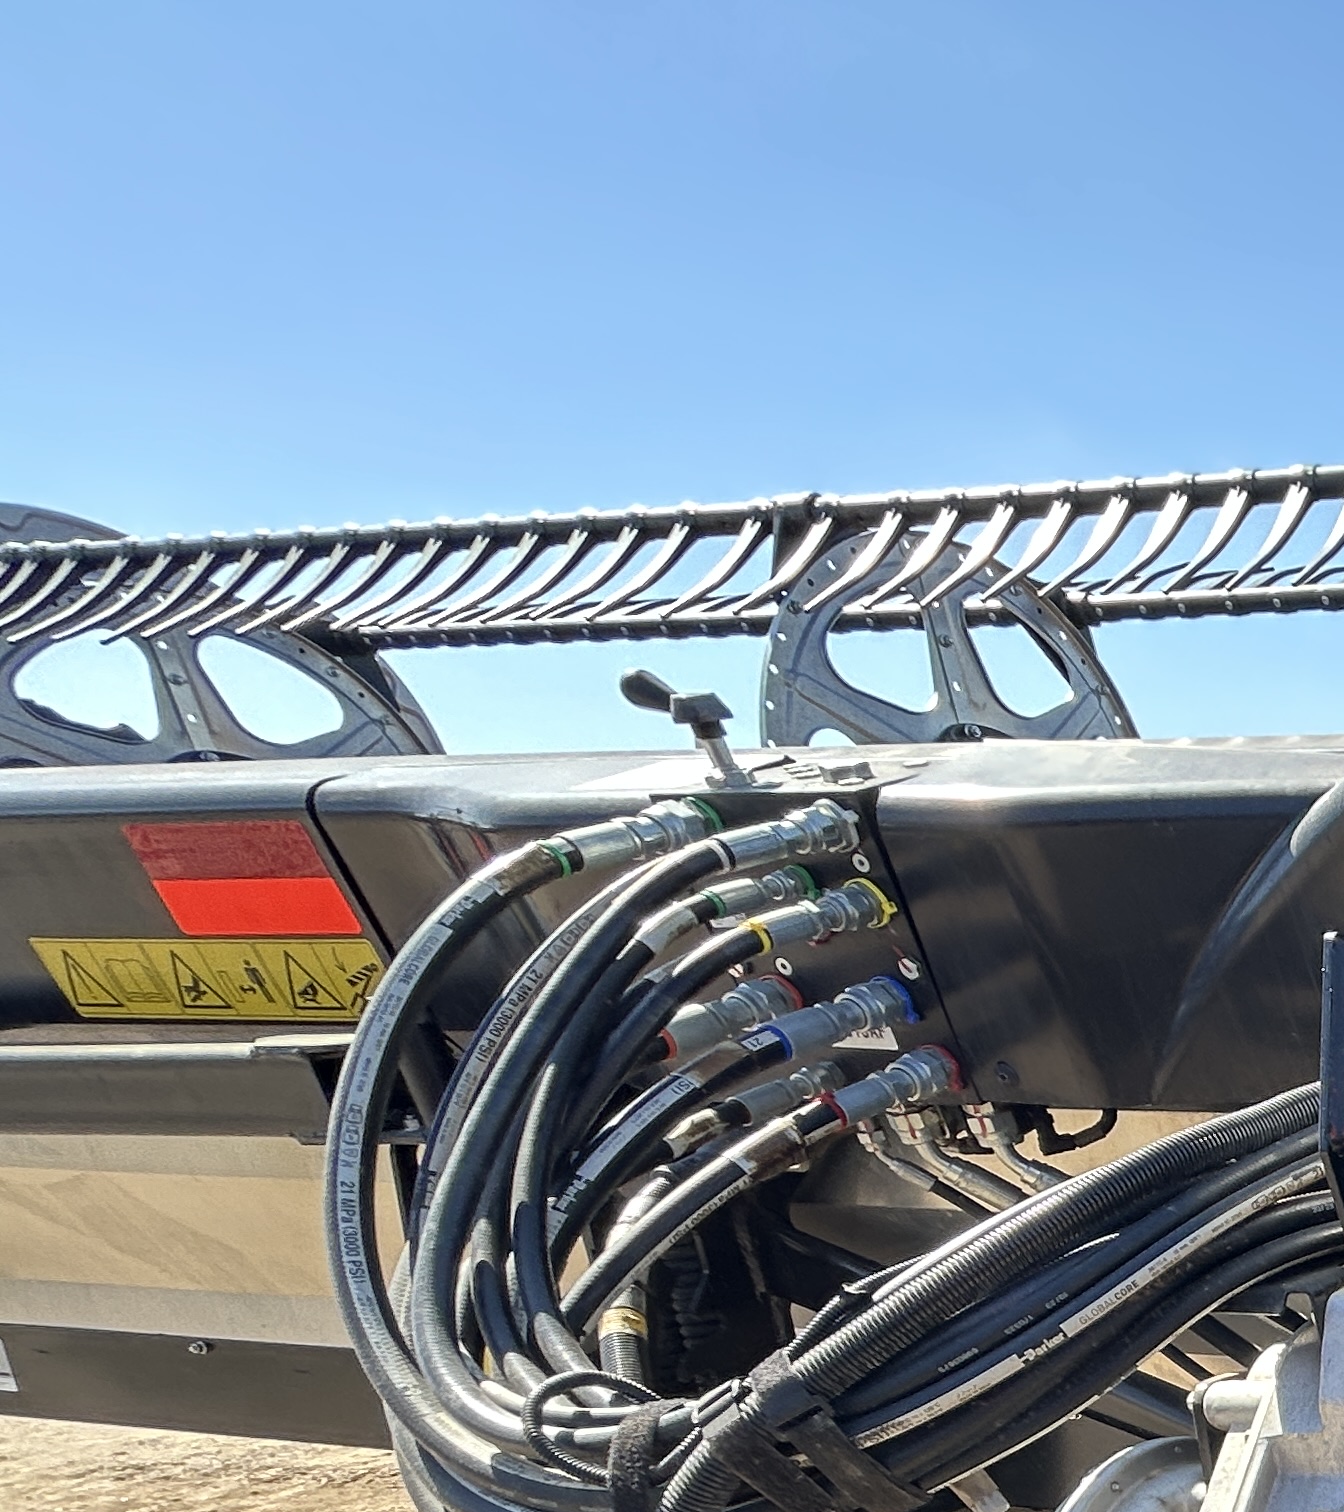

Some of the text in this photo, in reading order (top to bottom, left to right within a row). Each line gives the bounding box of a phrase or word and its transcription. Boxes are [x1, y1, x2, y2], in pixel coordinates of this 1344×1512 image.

[751, 1035, 764, 1047] 21
[340, 1181, 356, 1194] 21
[340, 1194, 356, 1224] MPa
[1078, 1279, 1140, 1327] GLOBALCORE
[1022, 1331, 1067, 1362] Parker
